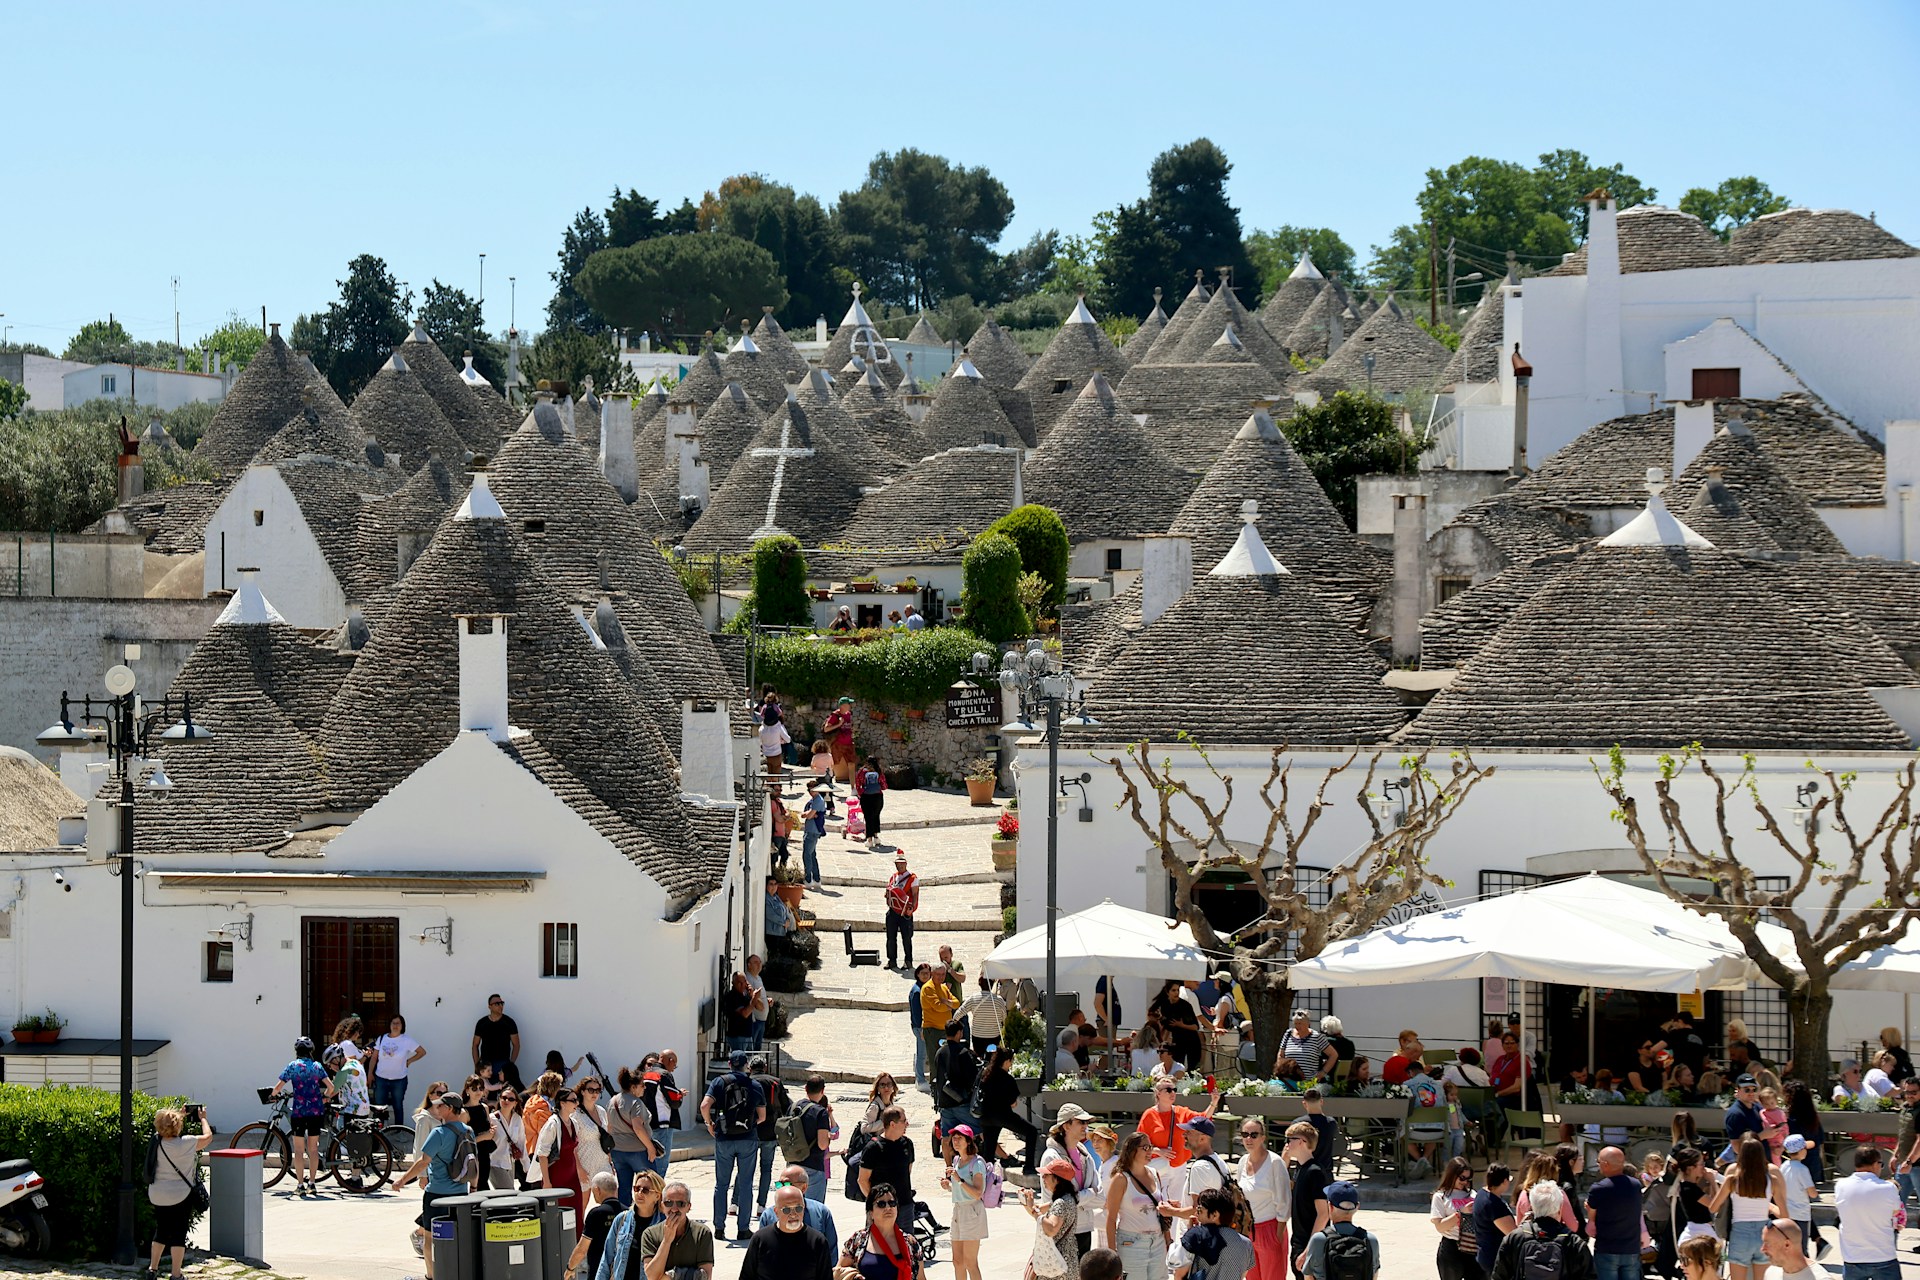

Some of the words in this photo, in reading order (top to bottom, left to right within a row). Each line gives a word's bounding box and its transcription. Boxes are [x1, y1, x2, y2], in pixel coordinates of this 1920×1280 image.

[960, 689, 986, 698] ZONA
[948, 697, 995, 707] MONUMENTALE
[954, 705, 991, 715] TRULLI
[948, 718, 969, 726] CHIESA
[976, 716, 999, 724] TRULLI
